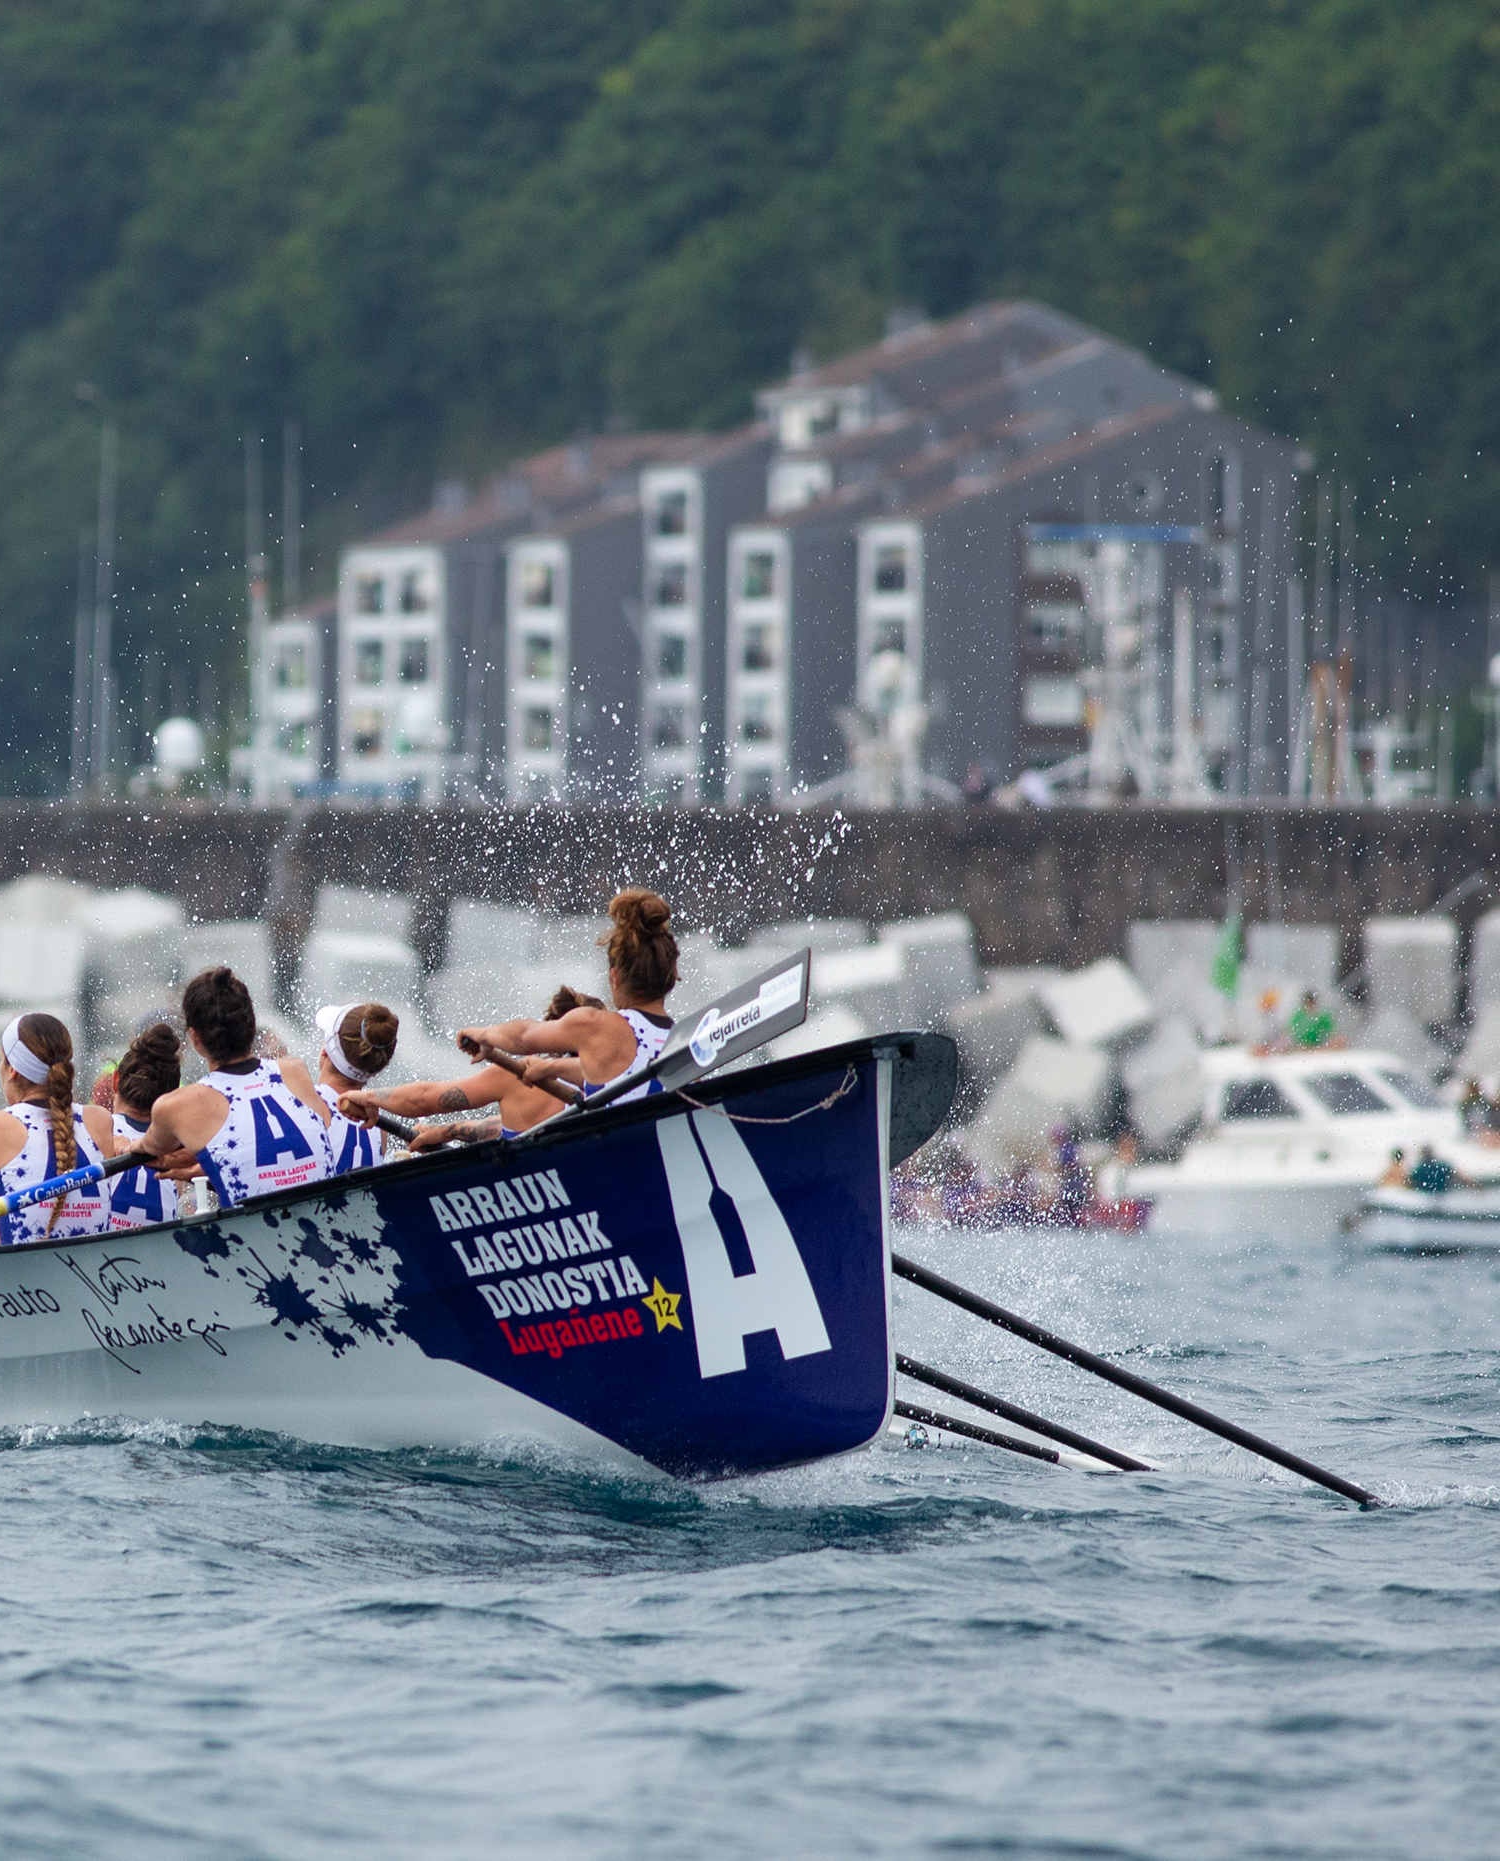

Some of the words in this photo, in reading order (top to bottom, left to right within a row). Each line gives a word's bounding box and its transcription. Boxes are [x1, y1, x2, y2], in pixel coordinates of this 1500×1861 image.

[258, 1169, 286, 1180] ARRAUN
[288, 1161, 317, 1175] LAGUNAK
[274, 1174, 308, 1186] DONOSTIA
[34, 1172, 94, 1202] CaixaBank
[429, 1168, 572, 1233] ARRAUN
[60, 1210, 92, 1218] ONOSTIA
[71, 1202, 102, 1210] LAGUNAK
[451, 1210, 613, 1277] LAGUNAK
[655, 1102, 833, 1380] A
[476, 1255, 649, 1319] DONOSTIA
[652, 1296, 675, 1318] 12
[498, 1307, 644, 1359] Lugañene
